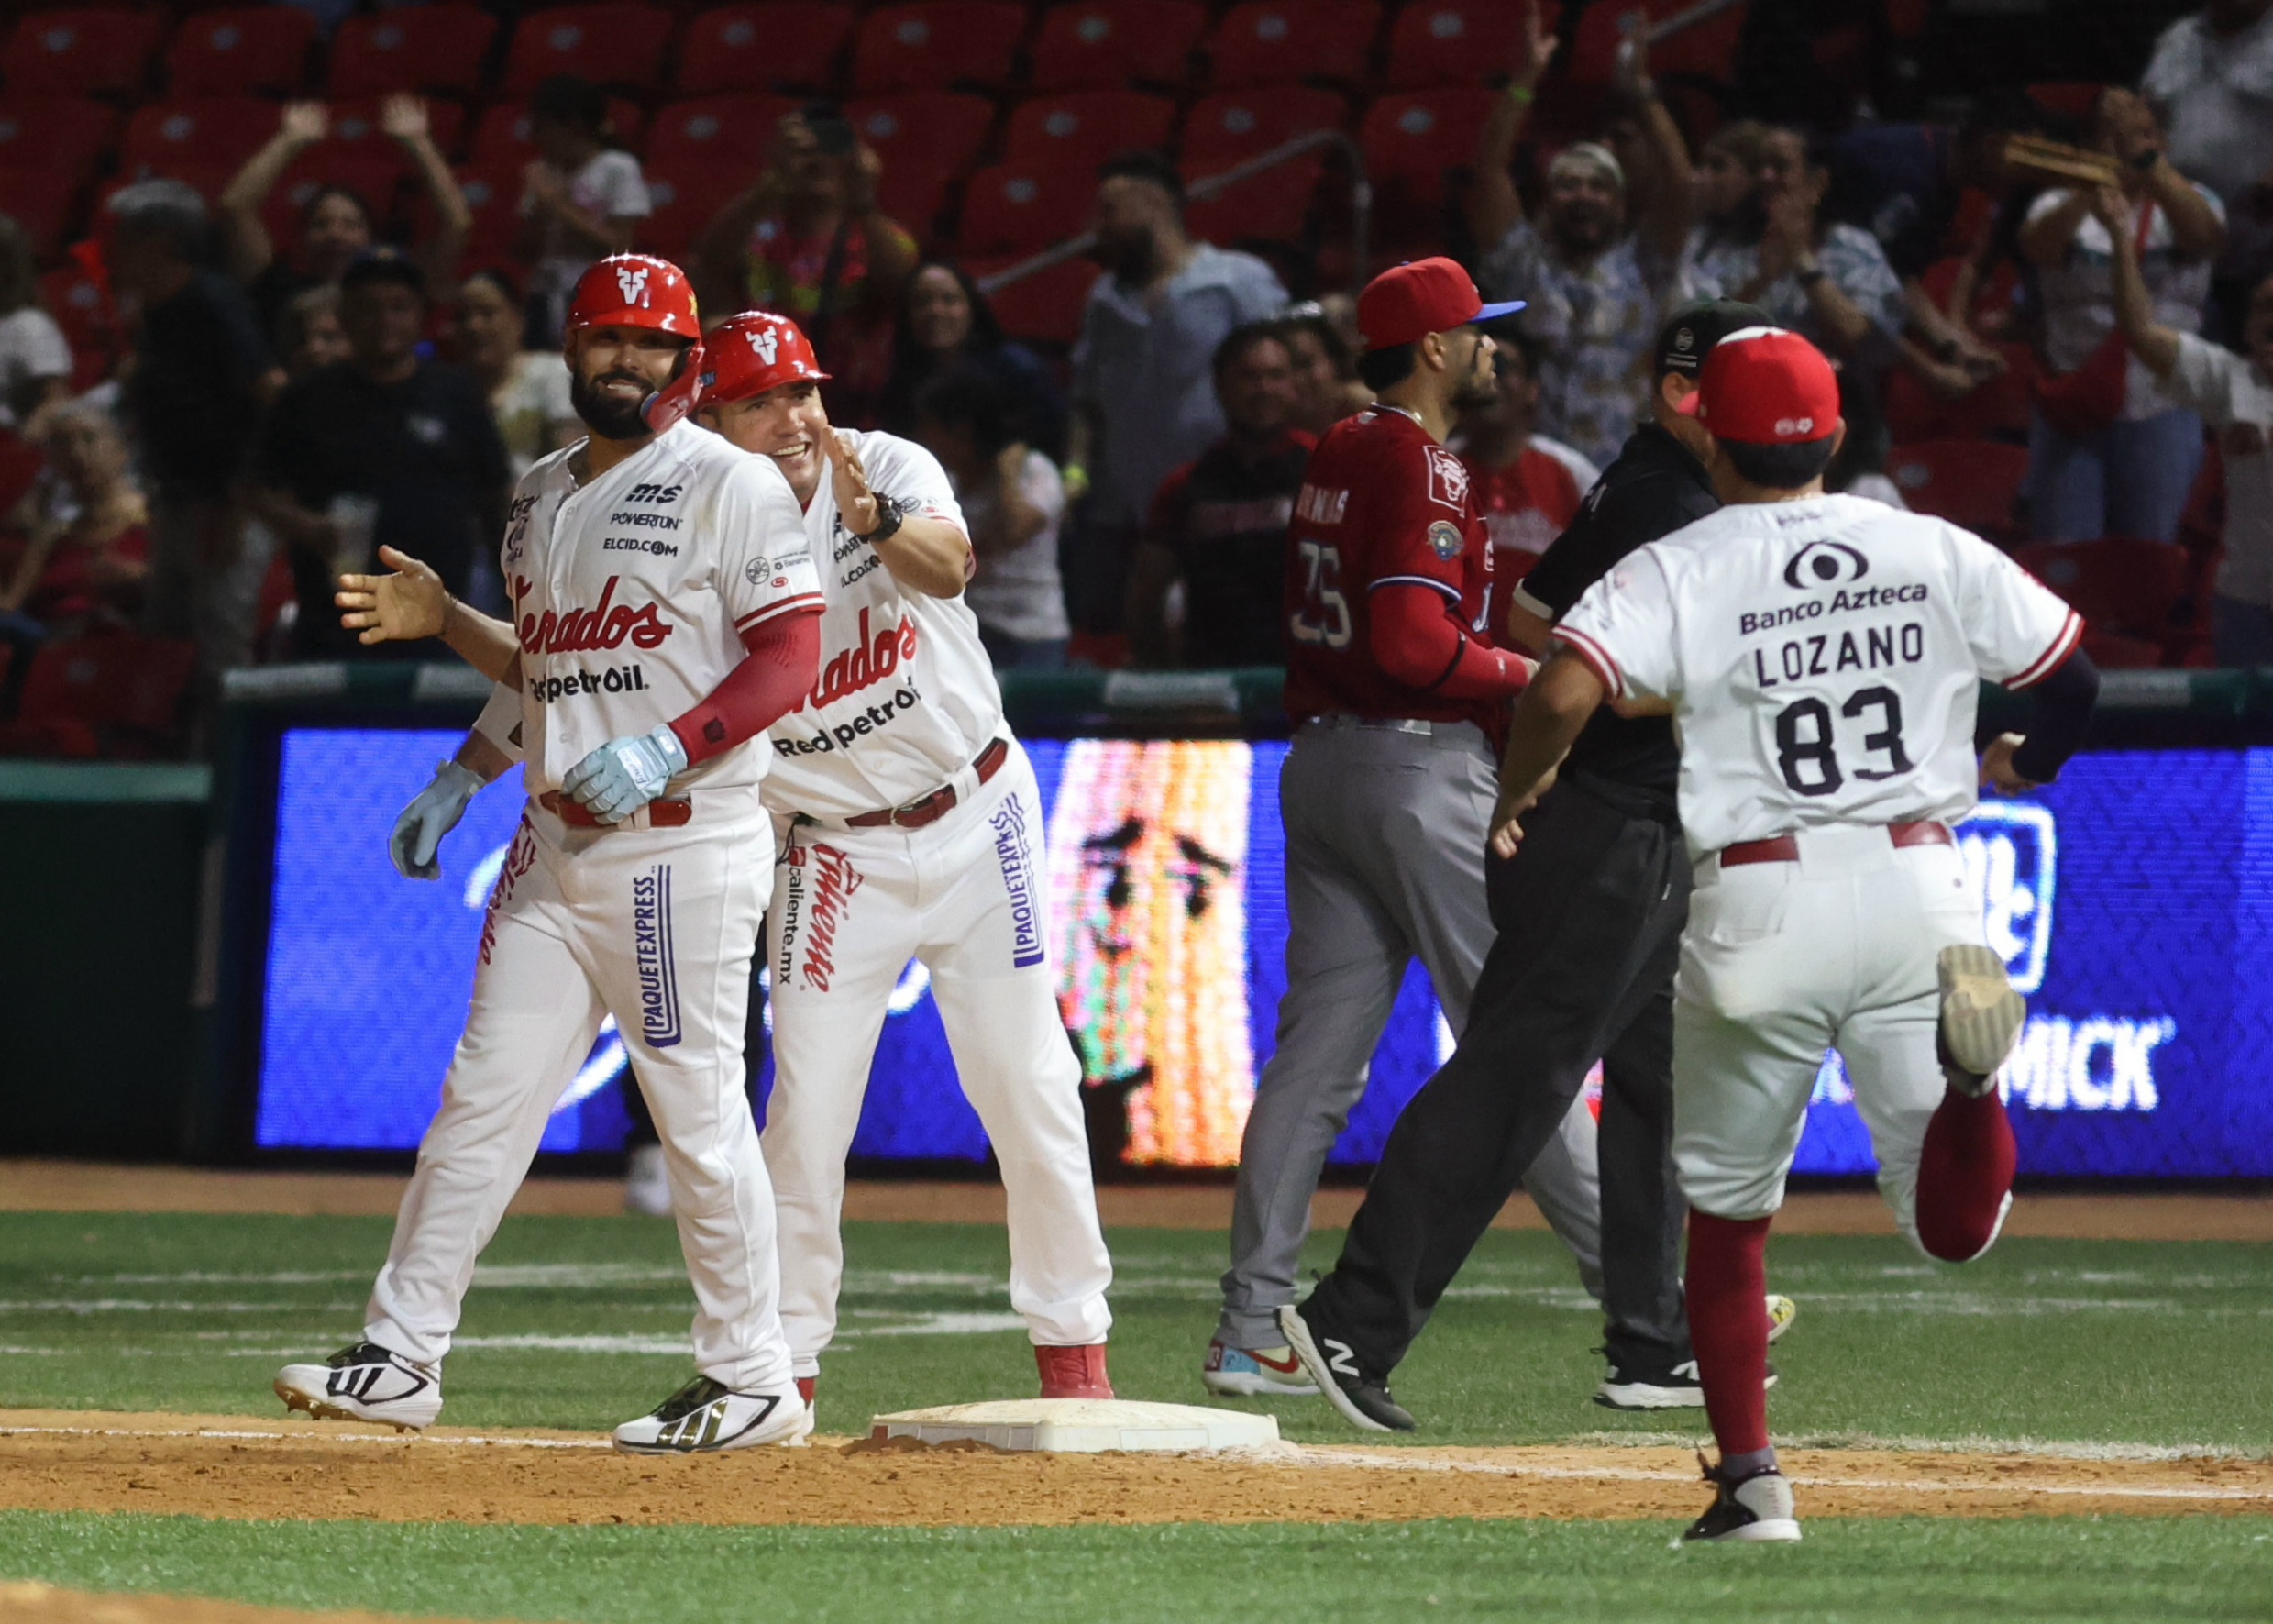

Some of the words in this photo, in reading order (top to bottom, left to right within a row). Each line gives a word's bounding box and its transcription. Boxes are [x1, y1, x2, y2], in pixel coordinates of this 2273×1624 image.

[625, 483, 683, 503] ms
[792, 605, 916, 713] ados
[1739, 600, 1823, 635] Banco
[1829, 583, 1928, 614] Azteca
[1755, 622, 1923, 688] LOZANO
[1774, 684, 1917, 796] 83
[634, 876, 665, 1028] PAQUETEXPRESS
[779, 867, 804, 985] caliente.mx
[803, 843, 864, 992] Caliente
